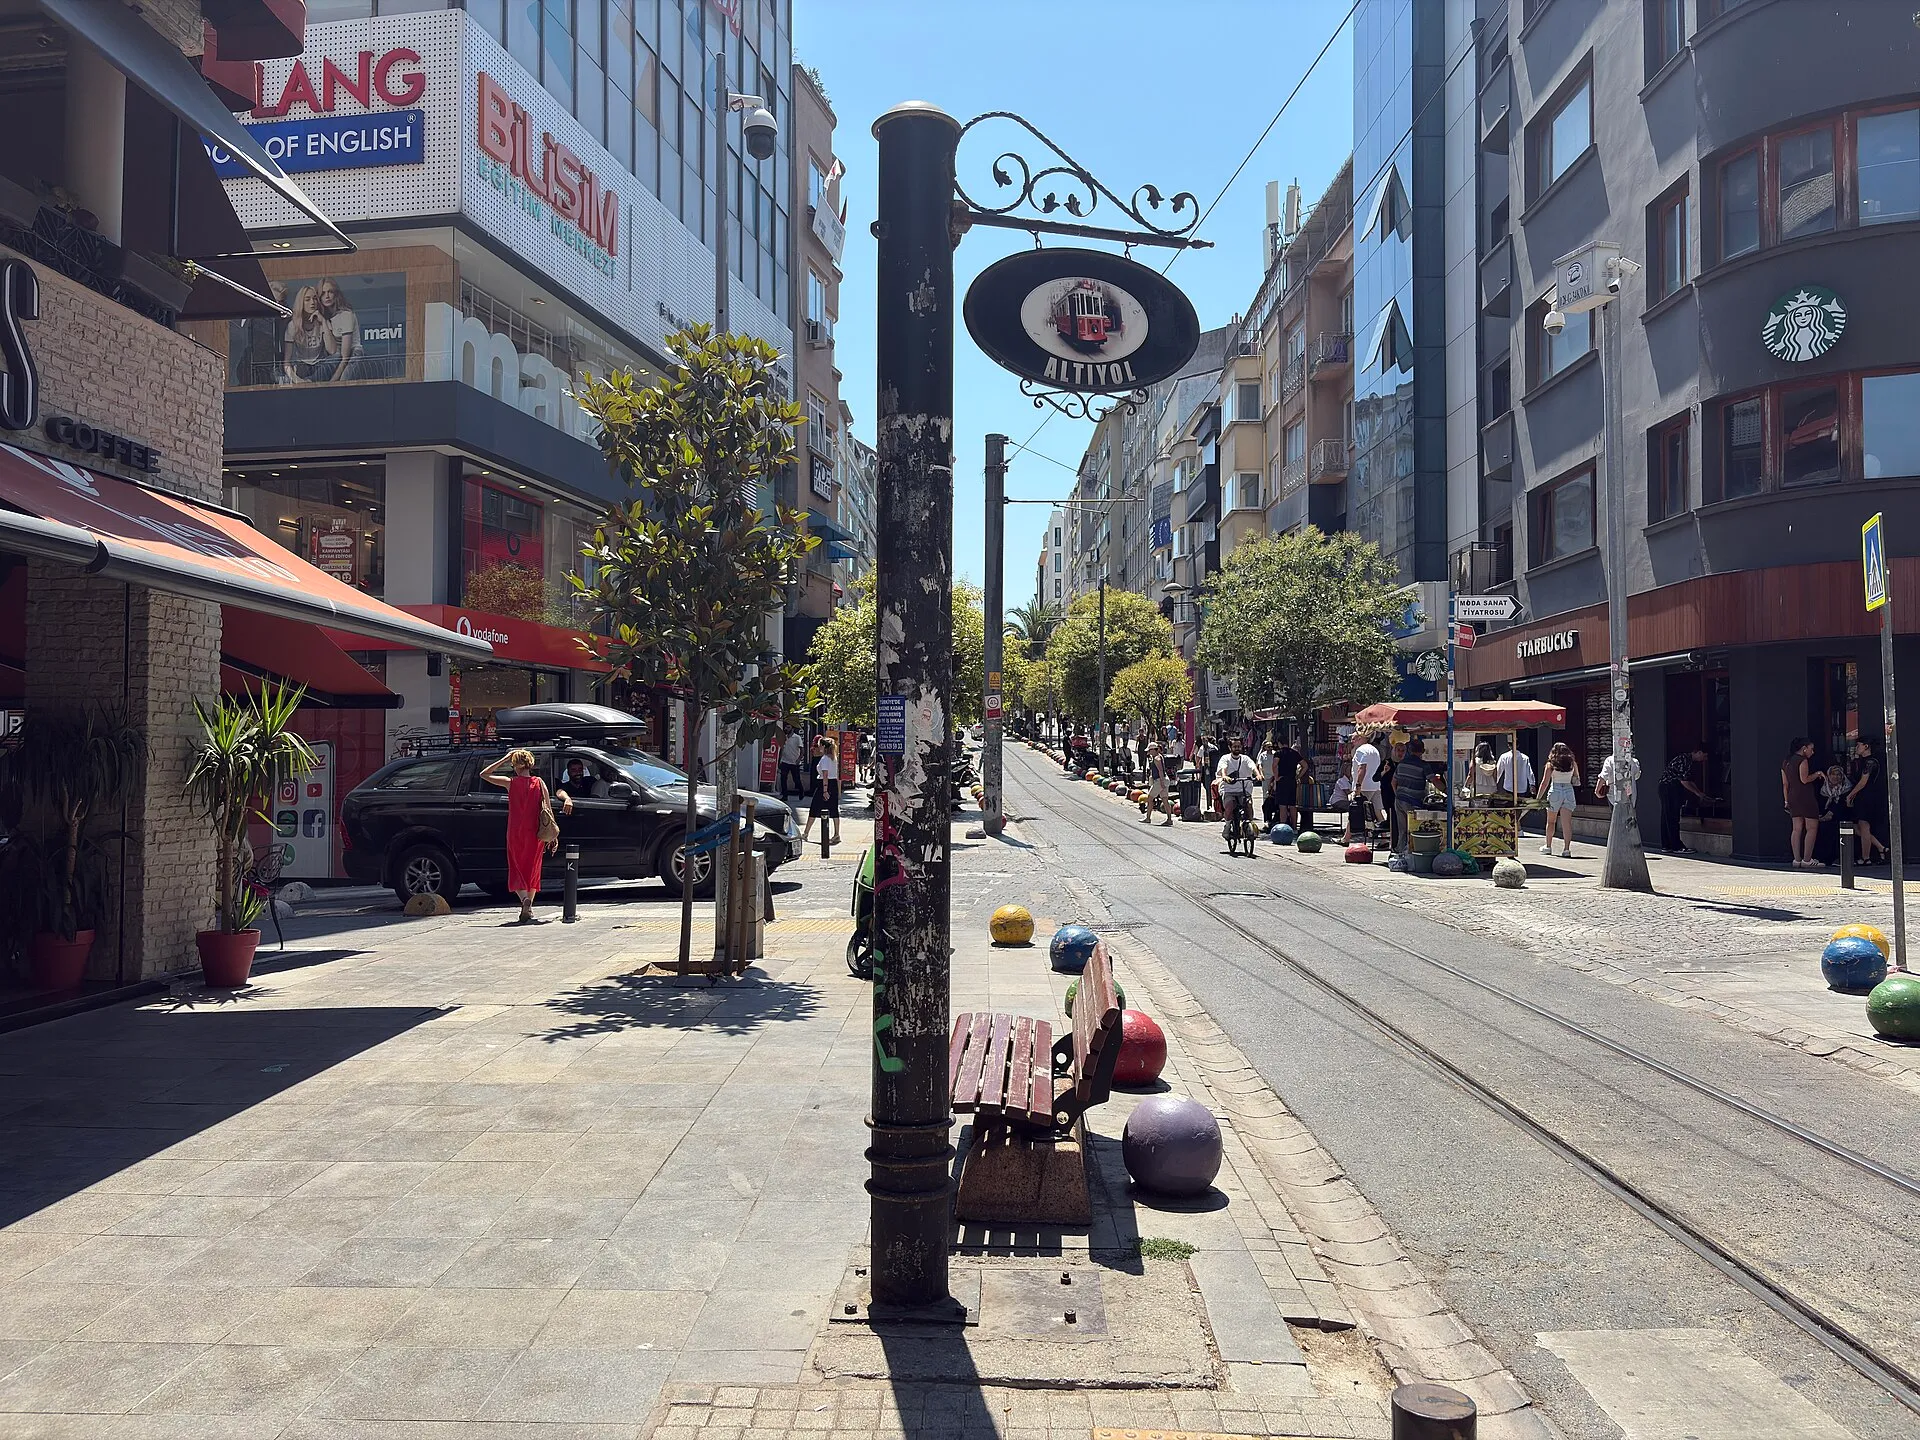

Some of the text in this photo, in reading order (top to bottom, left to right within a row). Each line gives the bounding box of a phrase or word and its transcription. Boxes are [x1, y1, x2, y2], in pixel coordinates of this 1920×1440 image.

[265, 125, 412, 160] OF ENGLISH
[364, 324, 403, 341] mavi
[1043, 356, 1137, 385] ALTIYOL
[44, 416, 161, 474] COFFEE
[1462, 608, 1505, 616] TİYATROSU
[472, 627, 509, 645] vodafone
[1517, 630, 1575, 659] STARBUCKS
